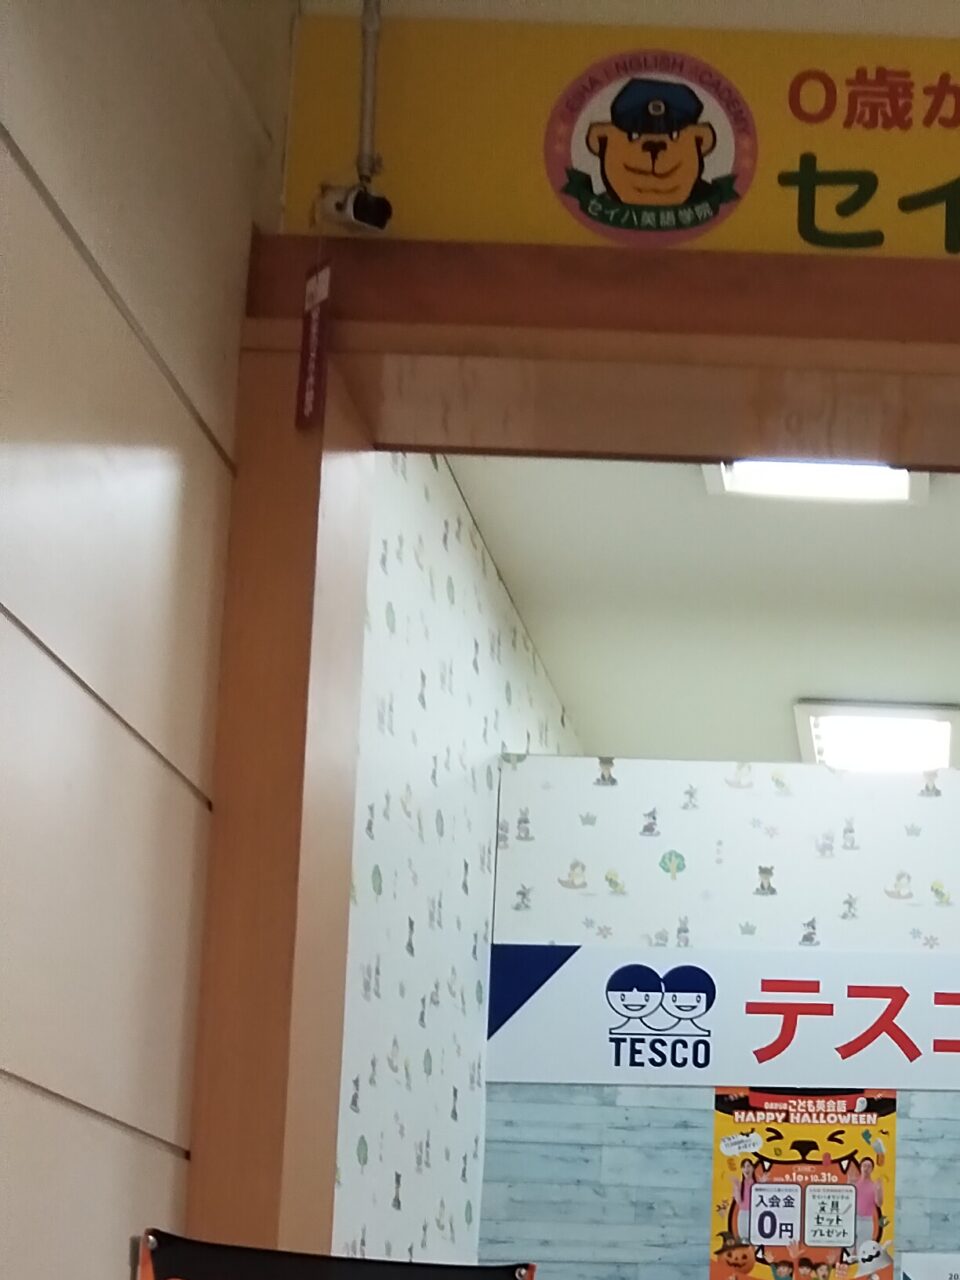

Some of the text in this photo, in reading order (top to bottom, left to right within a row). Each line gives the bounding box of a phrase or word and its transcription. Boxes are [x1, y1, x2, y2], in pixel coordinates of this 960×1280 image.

[610, 1037, 712, 1070] TESCO
[735, 1111, 878, 1125] HAPPY HALLOWEEN
[755, 1194, 796, 1208] 入会金
[758, 1210, 794, 1239] 0円
[814, 1214, 843, 1225] セット
